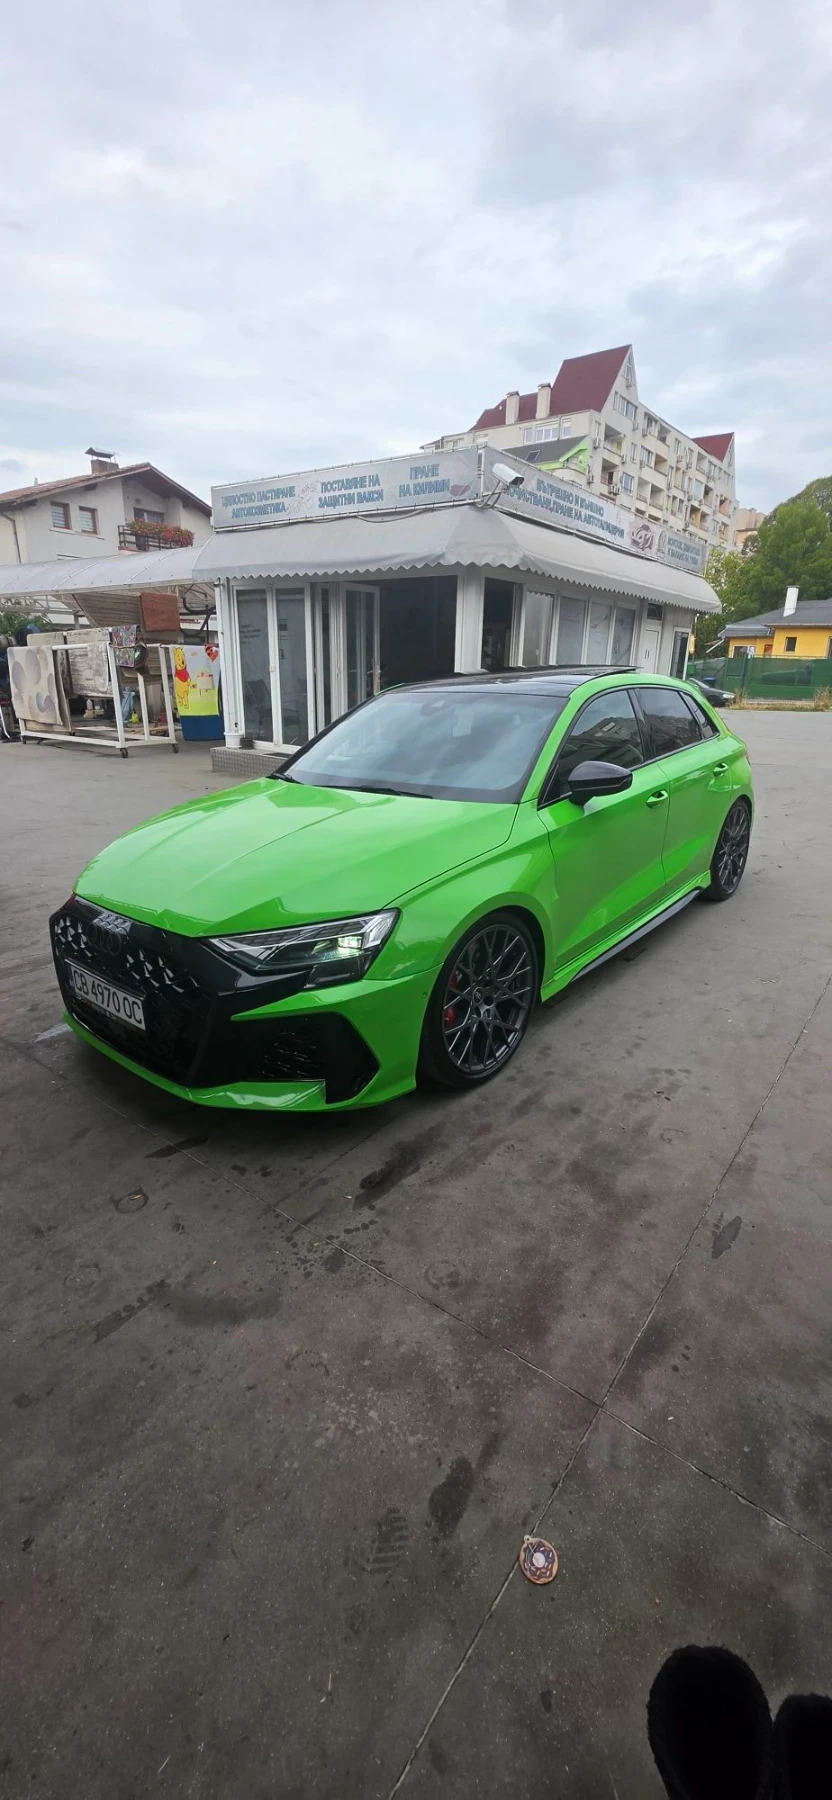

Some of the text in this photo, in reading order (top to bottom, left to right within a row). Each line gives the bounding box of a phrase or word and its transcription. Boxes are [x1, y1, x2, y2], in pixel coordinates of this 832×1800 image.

[409, 464, 440, 480] ПРАНЕ
[320, 474, 381, 494] ПОСТАВЯНЕ НА
[398, 478, 450, 498] НА КИЛИМИ
[318, 489, 384, 509] ЗАЩИТНИ ВАКСИ
[536, 478, 605, 517] ВЪТРЕШНО И ВЪНШНО
[573, 507, 583, 522] НА
[73, 970, 89, 996] CB
[91, 980, 121, 1014] 4970
[123, 997, 143, 1025] OC
